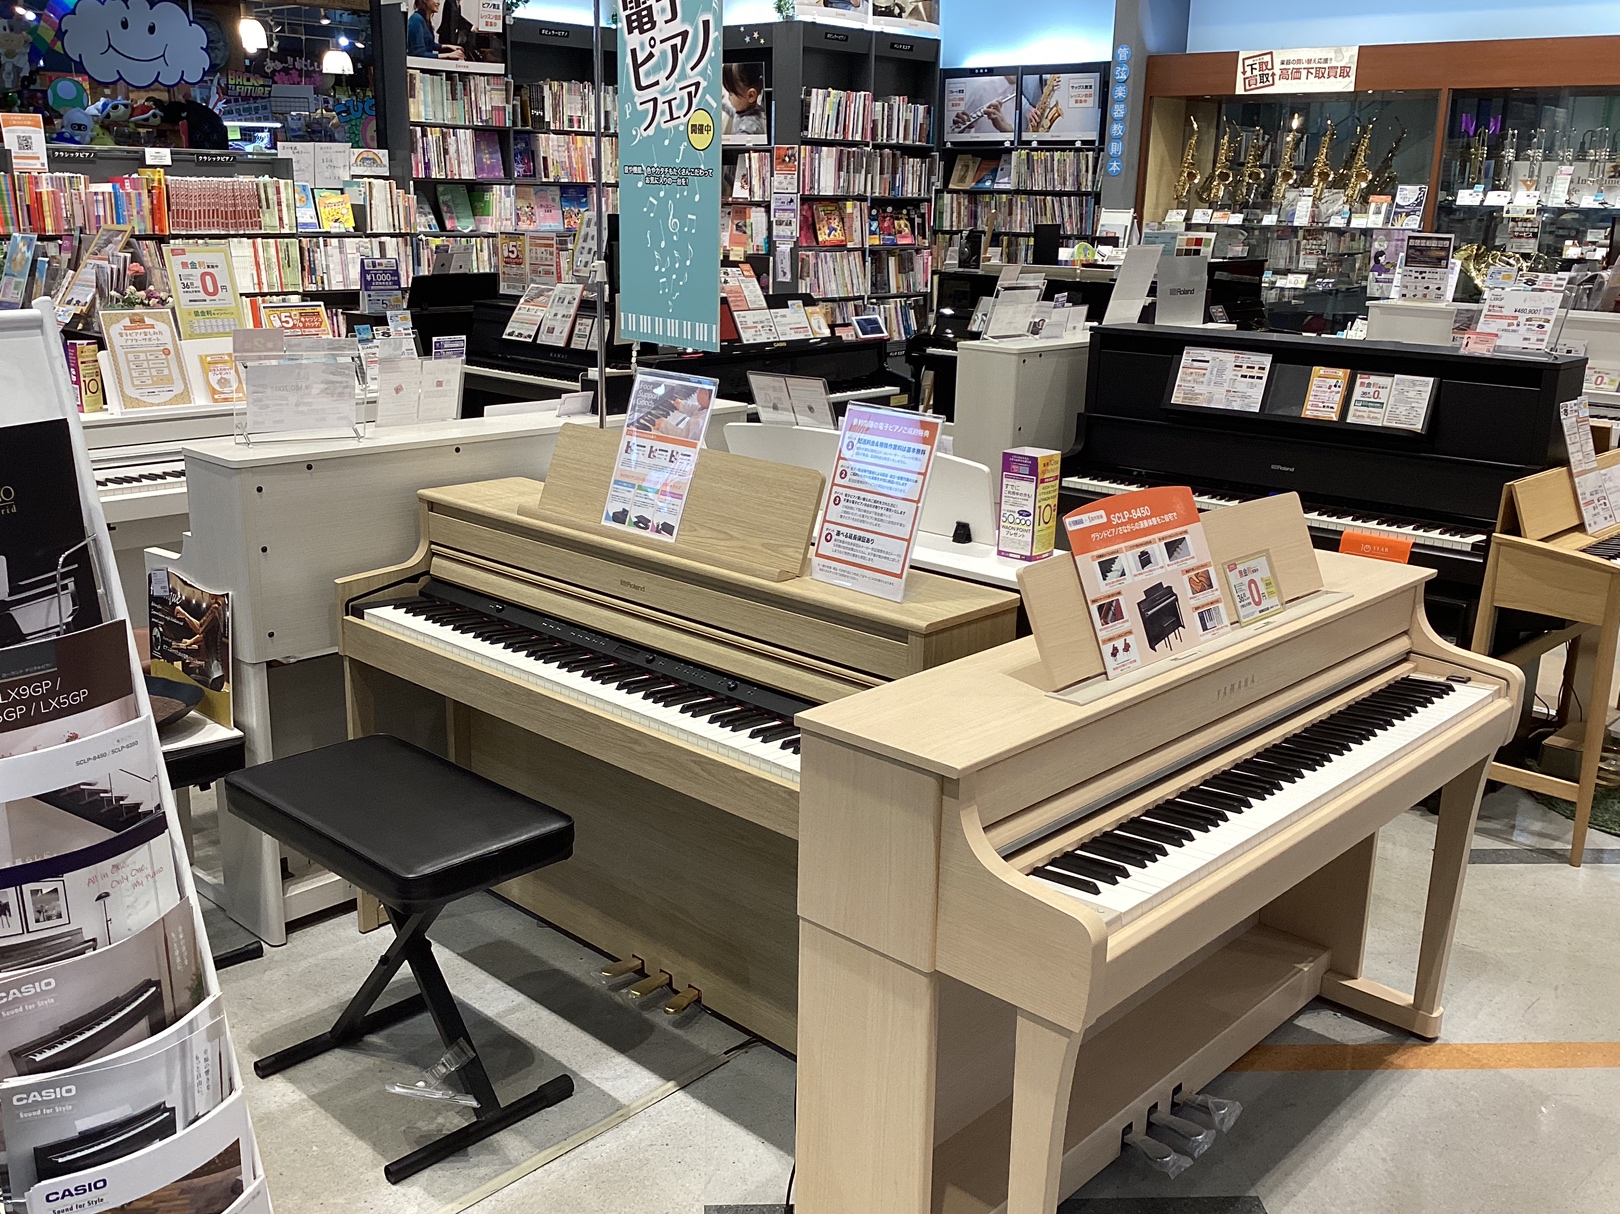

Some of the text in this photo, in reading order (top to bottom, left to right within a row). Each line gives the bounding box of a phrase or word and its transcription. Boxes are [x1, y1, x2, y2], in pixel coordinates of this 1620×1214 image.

[630, 19, 711, 91] ピアノ
[1246, 61, 1270, 75] 下取
[1279, 66, 1352, 81] 高価下取買取
[228, 70, 264, 86] BACK
[1247, 73, 1271, 87] 買取
[236, 86, 271, 98] FUTURE
[639, 81, 701, 132] フェア
[1109, 47, 1129, 173] 管弦楽器教則本
[690, 122, 712, 135] 開催中
[54, 151, 95, 159] クラシックピアノ
[1176, 287, 1195, 296] Roland
[638, 390, 660, 400] Support
[636, 399, 655, 408] Goods
[1278, 465, 1295, 473] Roland
[1005, 483, 1020, 491] すでに
[1002, 513, 1032, 527] 50,000
[1110, 505, 1152, 525] SCLP-8450
[1006, 531, 1025, 539] プレゼント
[626, 581, 646, 593] Roland
[40, 688, 89, 713] LX5GP
[75, 751, 107, 767] SCLP-8450
[1, 997, 55, 1018] Sound for Style
[12, 1085, 77, 1106] CASIO
[19, 1109, 41, 1118] Sound
[55, 1105, 73, 1113] Style
[45, 1178, 108, 1203] CASIO
[52, 1197, 104, 1214] Sound for Style
